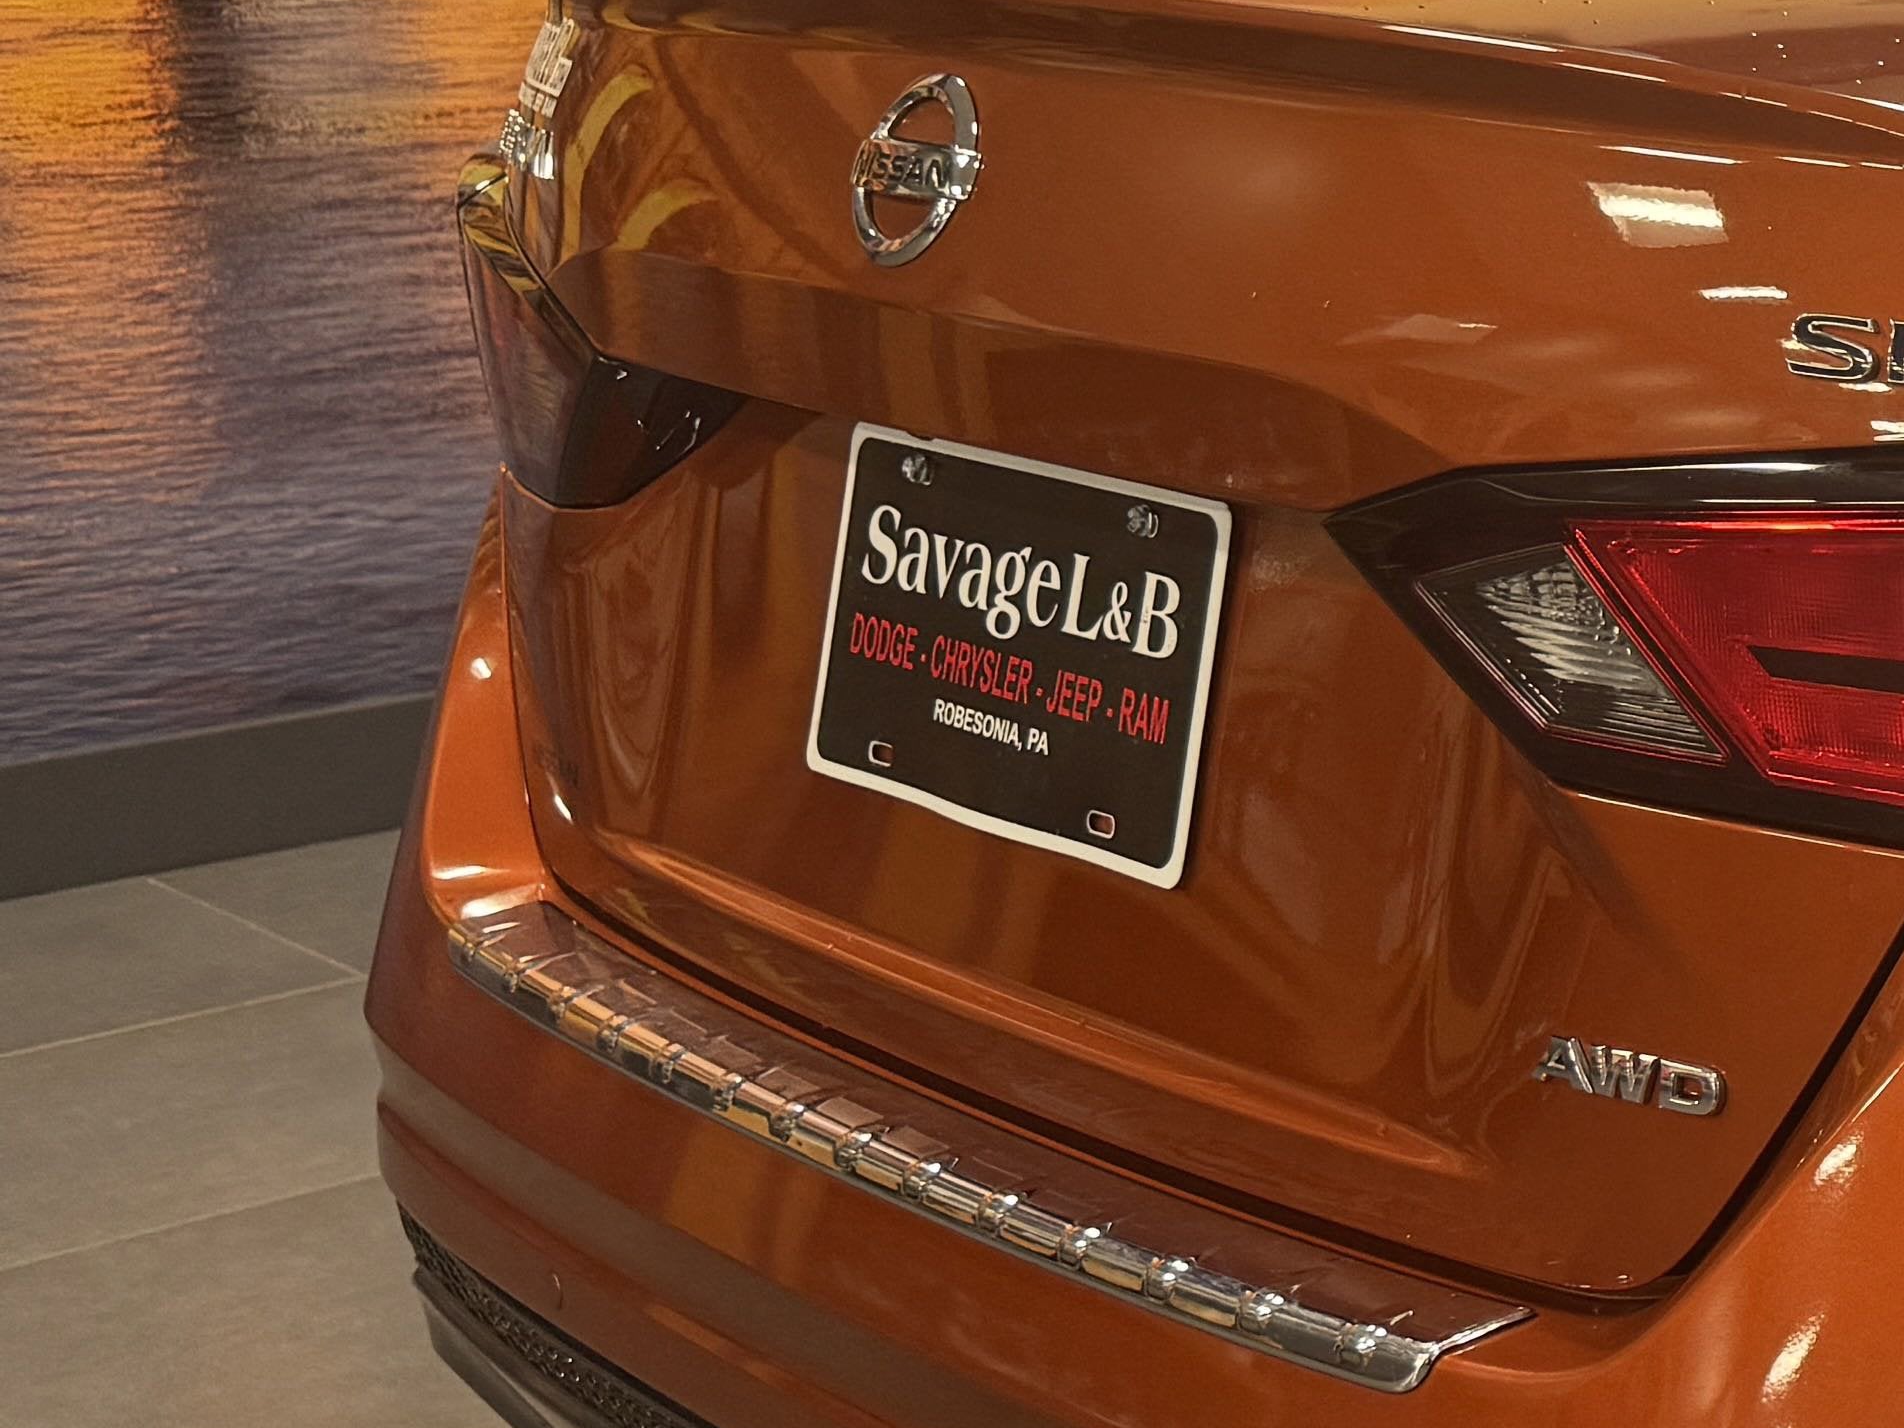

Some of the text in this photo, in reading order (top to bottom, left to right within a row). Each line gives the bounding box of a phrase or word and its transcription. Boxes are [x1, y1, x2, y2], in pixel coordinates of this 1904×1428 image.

[849, 612, 1170, 745] DODGE CHRYSLER JEEP RAM
[933, 699, 1049, 756] ROBESONIA, PA
[1531, 1035, 1726, 1116] AWD
